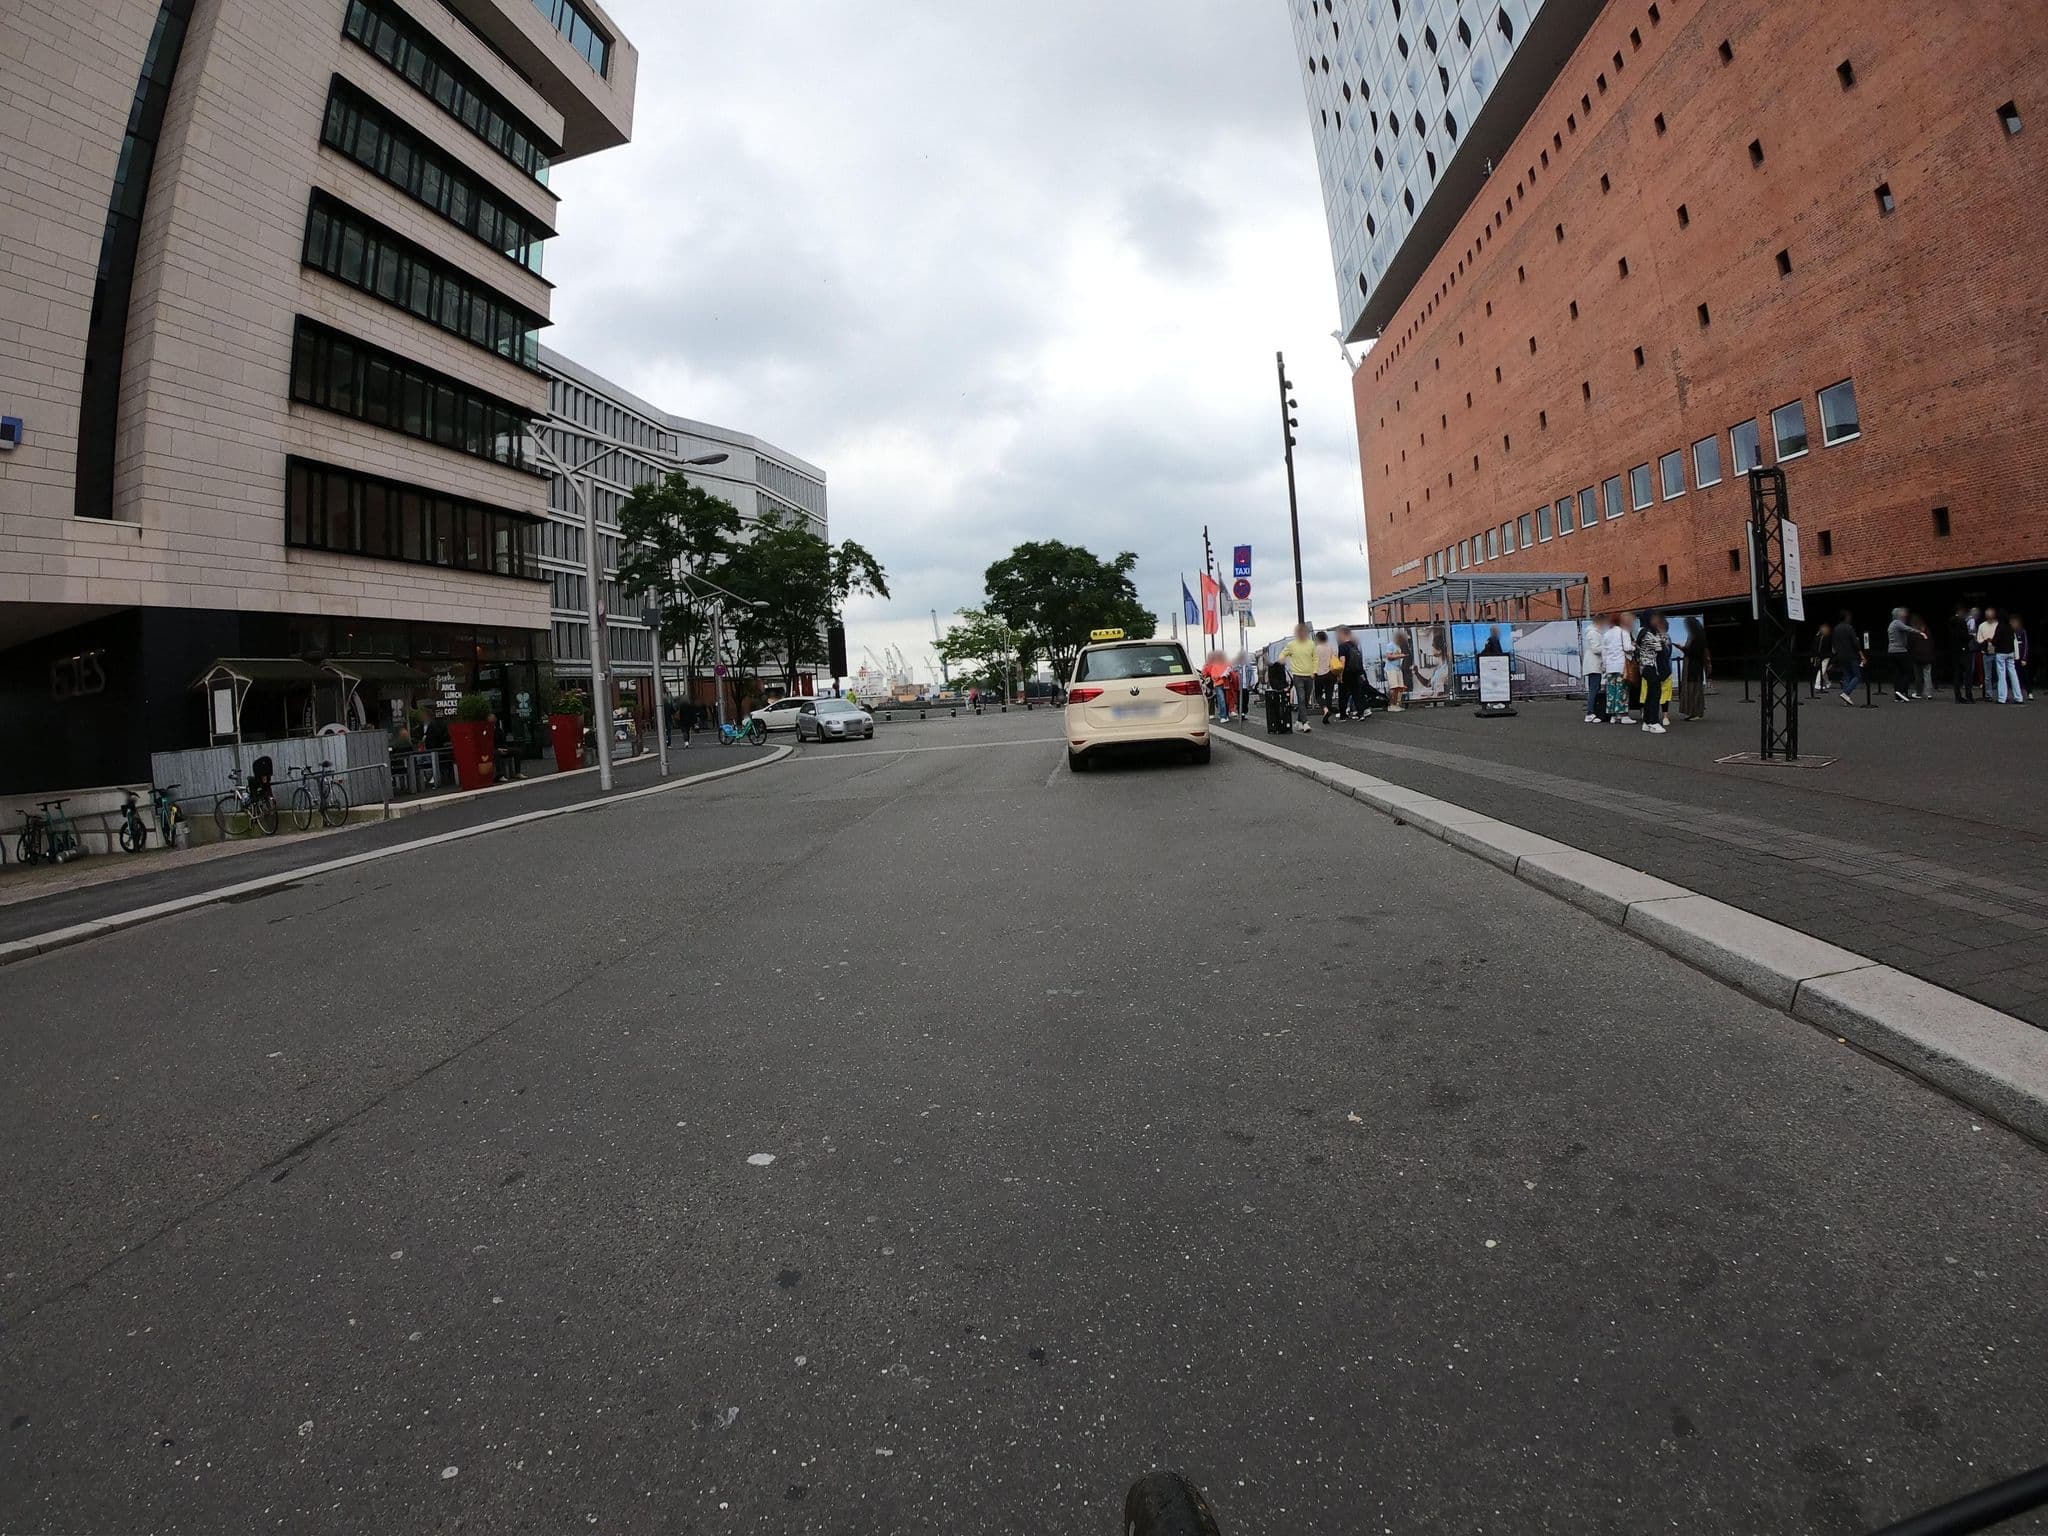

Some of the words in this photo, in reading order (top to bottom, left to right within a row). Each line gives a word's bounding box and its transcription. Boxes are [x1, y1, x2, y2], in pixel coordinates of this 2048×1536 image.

[1234, 567, 1251, 575] TAXI
[444, 691, 462, 699] LUNCH
[436, 699, 458, 707] SNACKS
